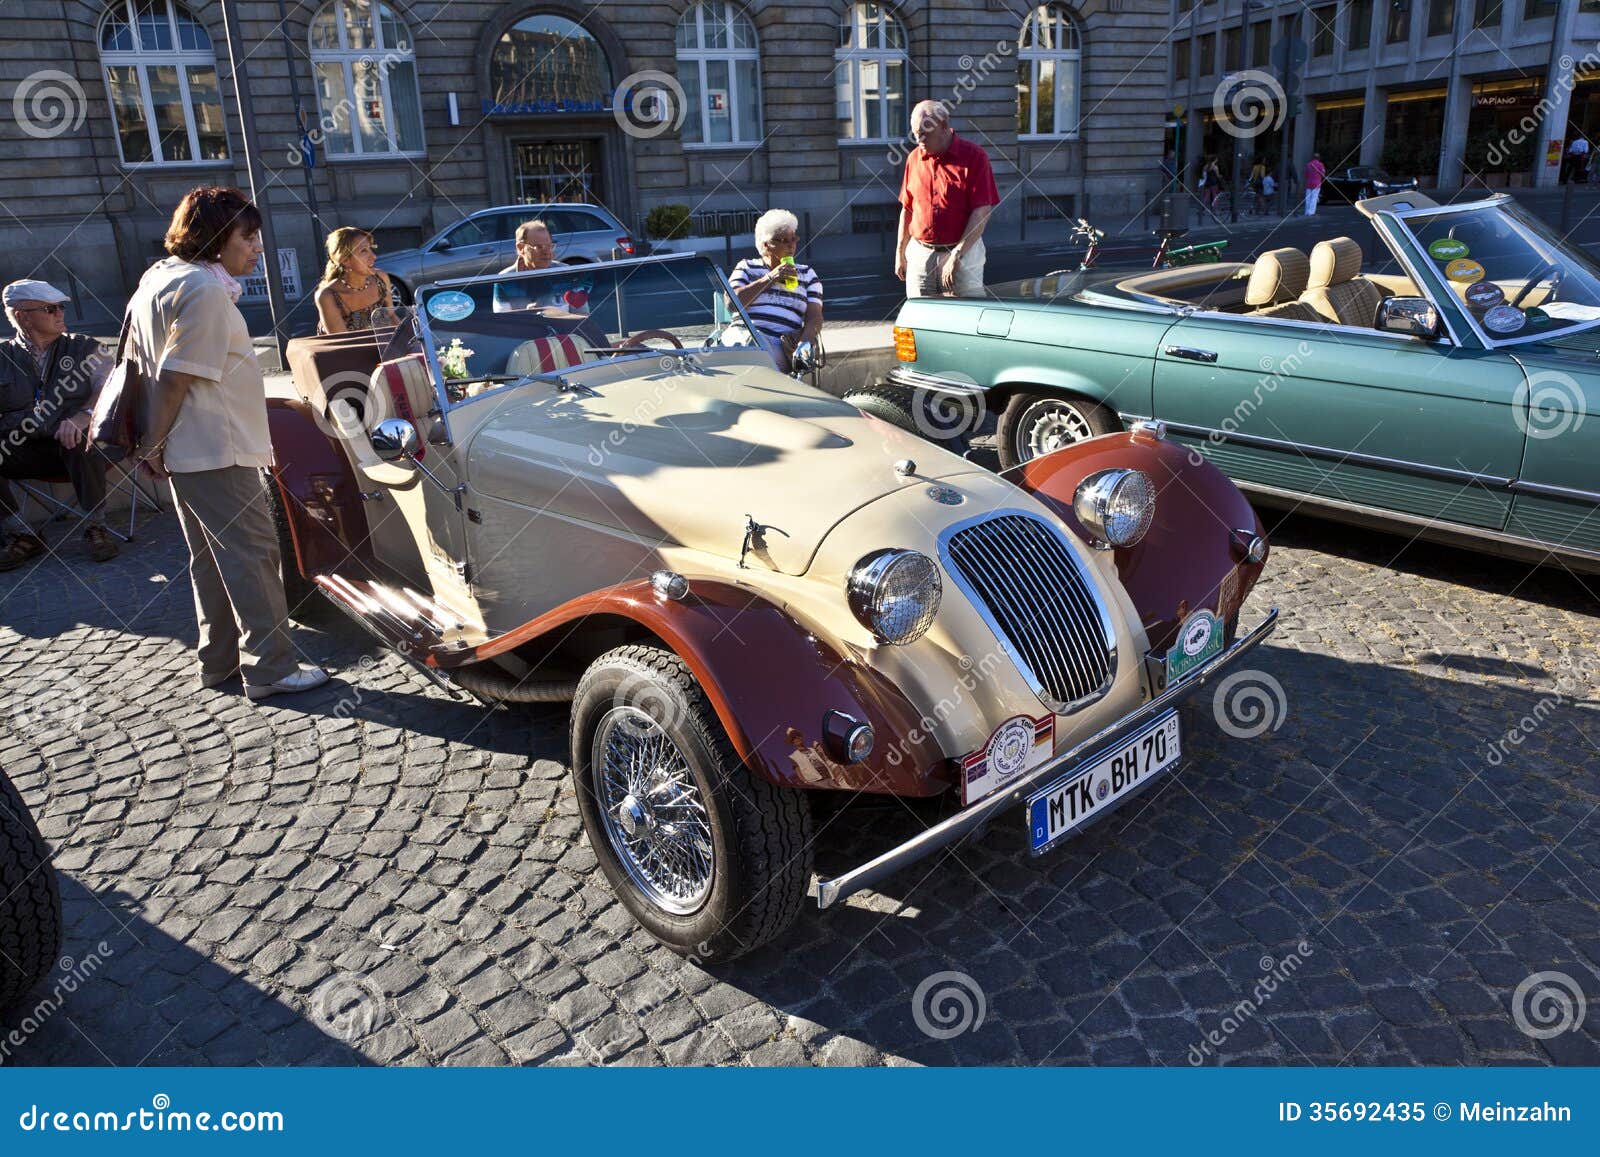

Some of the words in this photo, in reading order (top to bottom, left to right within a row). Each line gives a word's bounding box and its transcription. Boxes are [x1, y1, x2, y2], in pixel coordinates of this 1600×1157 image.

[1477, 97, 1517, 105] VAPIANO
[1167, 719, 1177, 733] 03
[1049, 773, 1095, 833] MTK
[1111, 746, 1139, 794] BH
[1142, 728, 1167, 773] 70
[1036, 826, 1044, 839] D
